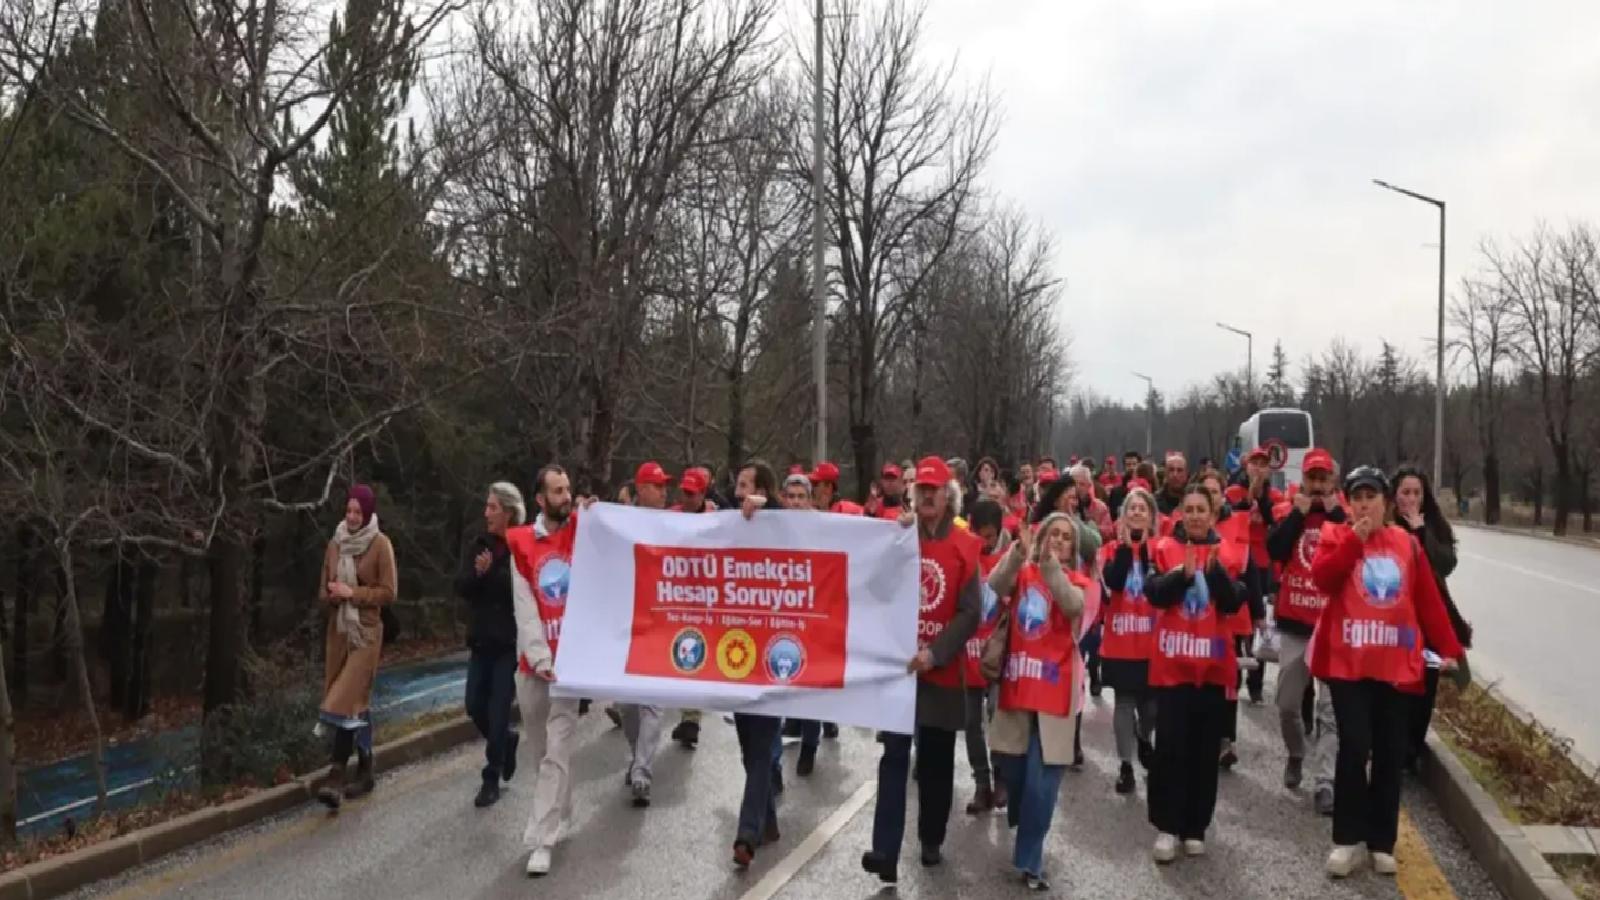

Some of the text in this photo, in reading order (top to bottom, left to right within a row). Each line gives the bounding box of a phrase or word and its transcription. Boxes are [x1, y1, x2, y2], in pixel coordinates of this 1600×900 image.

[662, 553, 812, 587] ODTÜ Emekçisi
[656, 580, 815, 612] Hesap Soruyor!
